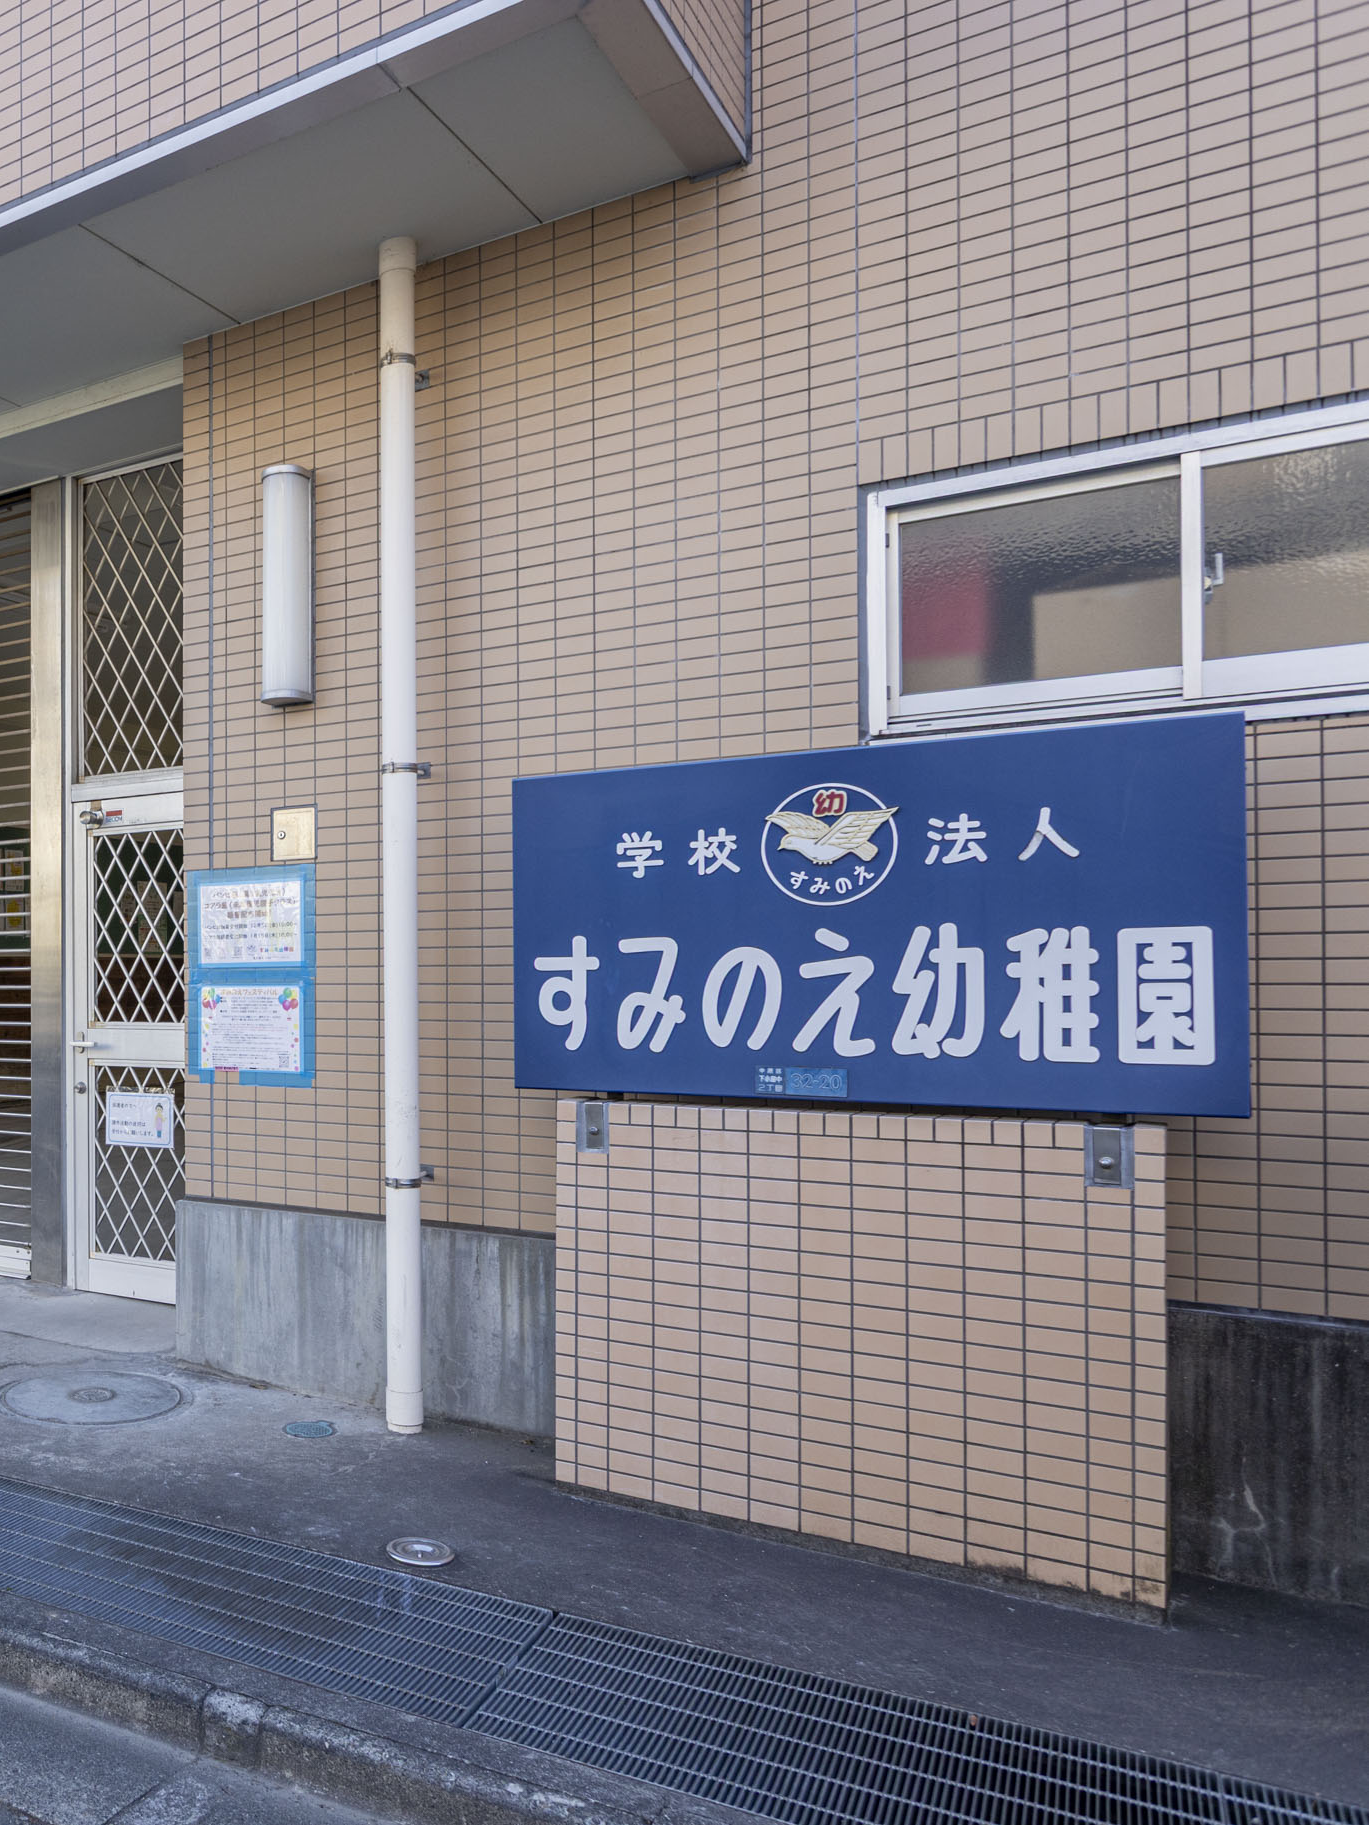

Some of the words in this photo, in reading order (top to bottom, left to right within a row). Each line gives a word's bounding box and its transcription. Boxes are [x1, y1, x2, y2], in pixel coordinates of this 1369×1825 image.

[813, 790, 847, 817] 幼
[616, 828, 741, 879] 学校
[924, 806, 1081, 865] 法人
[789, 865, 876, 895] すみのえ
[534, 922, 1217, 1066] すみのえ幼稚園
[790, 1072, 844, 1090] 32-20
